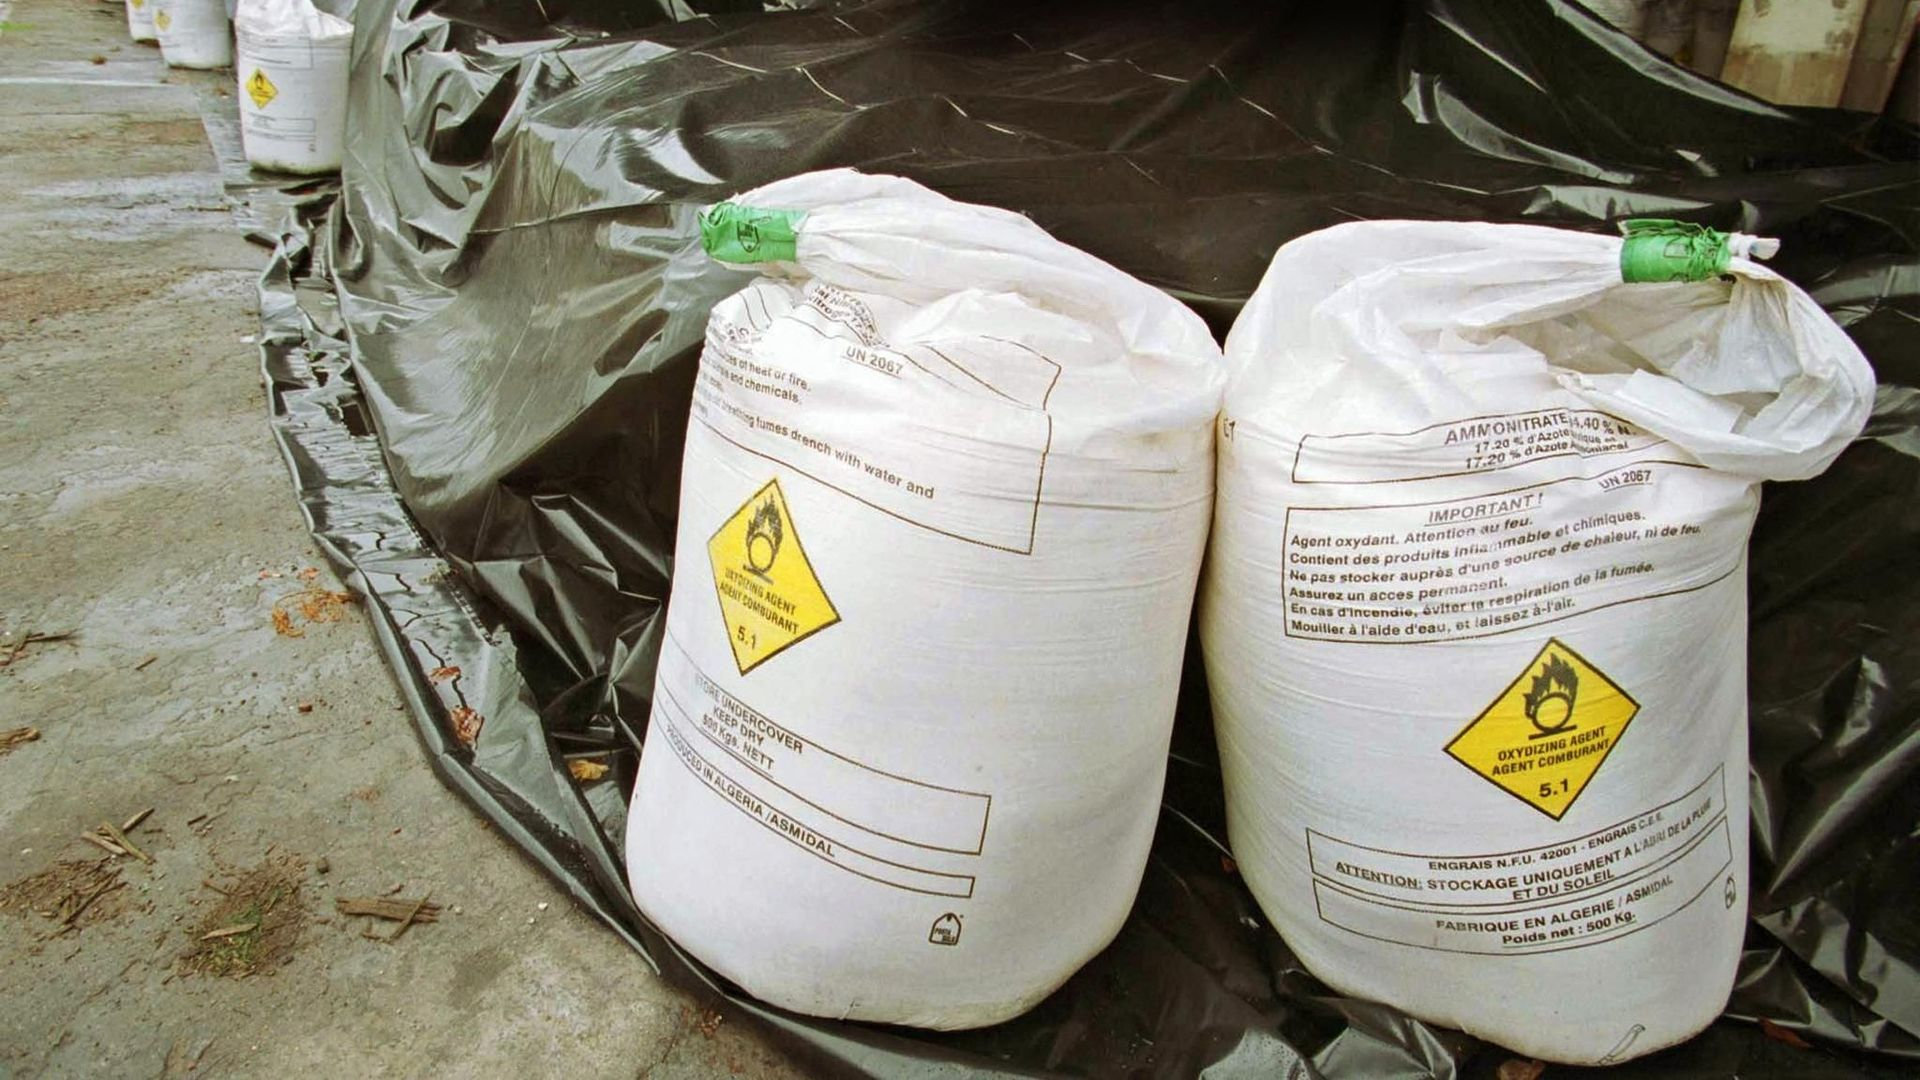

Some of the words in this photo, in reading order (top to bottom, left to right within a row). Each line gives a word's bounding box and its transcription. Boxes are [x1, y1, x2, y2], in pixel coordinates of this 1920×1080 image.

[774, 370, 786, 381] or
[846, 347, 867, 365] UN
[870, 353, 903, 375] 2067
[1444, 412, 1569, 445] AMMONITRATE
[1602, 419, 1614, 435] %
[1475, 439, 1510, 454] 17.20
[1513, 436, 1524, 446] %
[1527, 428, 1570, 445] d'Azote
[756, 415, 789, 437] fumes
[791, 429, 832, 457] drench
[834, 446, 861, 469] with
[863, 461, 903, 487] water
[905, 480, 936, 500] and
[1466, 454, 1506, 469] 17.20
[1510, 450, 1521, 459] %
[1524, 443, 1568, 456] d'Azote
[1600, 475, 1619, 490] UN
[1622, 469, 1652, 485] 2067
[1290, 552, 1348, 566] Contient
[1352, 551, 1380, 565] des
[1384, 546, 1450, 567] produits
[1555, 525, 1570, 538] et
[1572, 508, 1647, 534] chimiques.
[1291, 534, 1332, 549] Agent
[1335, 535, 1400, 551] oxydant.
[1404, 527, 1476, 544] Attention
[1480, 523, 1501, 535] au
[1504, 515, 1534, 530] feu.
[1290, 569, 1307, 582] Ne
[1310, 572, 1336, 585] pas
[1340, 570, 1396, 584] stocker
[1400, 566, 1454, 586] auprès
[1458, 559, 1500, 576] d'une
[1504, 546, 1557, 567] source
[1560, 540, 1582, 554] de
[1583, 528, 1642, 549] chaleur,
[1644, 526, 1658, 538] ni
[1660, 524, 1678, 537] de
[765, 591, 796, 616] AGENT
[1289, 586, 1343, 601] Assurez
[1347, 591, 1365, 601] un
[1369, 589, 1414, 601] acces
[1418, 576, 1508, 601] permanent.
[1291, 603, 1308, 615] En
[1310, 605, 1334, 617] cas
[1422, 601, 1470, 616] éviter
[1488, 579, 1570, 607] respiration
[1573, 571, 1592, 586] de
[1594, 567, 1608, 582] la
[1610, 560, 1656, 578] fumée.
[742, 592, 799, 635] COMBURANT
[1291, 619, 1345, 635] Mouiller
[1348, 622, 1357, 636] à
[1361, 624, 1400, 637] l'aide
[1404, 623, 1452, 636] d'eau,
[1455, 621, 1470, 631] et
[1474, 608, 1530, 629] laissez
[737, 625, 757, 650] 5.1
[703, 714, 718, 733] 500
[743, 741, 775, 770] NETT
[713, 706, 738, 728] KEEP
[740, 723, 765, 746] DRY
[721, 695, 803, 754] UNDERCOVER
[1491, 758, 1536, 777] AGENT
[1538, 738, 1611, 769] COMBURANT
[1497, 738, 1567, 762] OXYDIZING
[1570, 725, 1607, 748] AGENT
[666, 724, 702, 772] PRODUCED
[703, 766, 713, 781] IN
[714, 775, 763, 816] ALGERIA
[1539, 778, 1571, 799] 5.1
[1336, 861, 1423, 890] ATTENTION:
[1427, 876, 1518, 891] STOCKAGE
[1522, 850, 1621, 886] UNIQUEMENT
[1624, 846, 1633, 859] A
[1667, 823, 1681, 838] DE
[1681, 816, 1692, 831] LA
[1428, 859, 1493, 871] ENGRAIS
[1496, 854, 1536, 868] N.F.U.
[1540, 845, 1578, 861] 42001
[1588, 821, 1637, 849] ENGRAIS
[1436, 919, 1519, 932] FABRIQUE
[1524, 916, 1546, 930] EN
[1550, 900, 1616, 924] ALGERIE
[1626, 874, 1674, 905] ASMIDAL
[1513, 888, 1533, 901] ET
[1537, 883, 1559, 897] DU
[1563, 868, 1616, 893] SOLEIL
[1502, 931, 1547, 946] Poids
[1550, 926, 1575, 940] net
[1586, 916, 1612, 932] 500
[1614, 909, 1637, 928] Kg.
